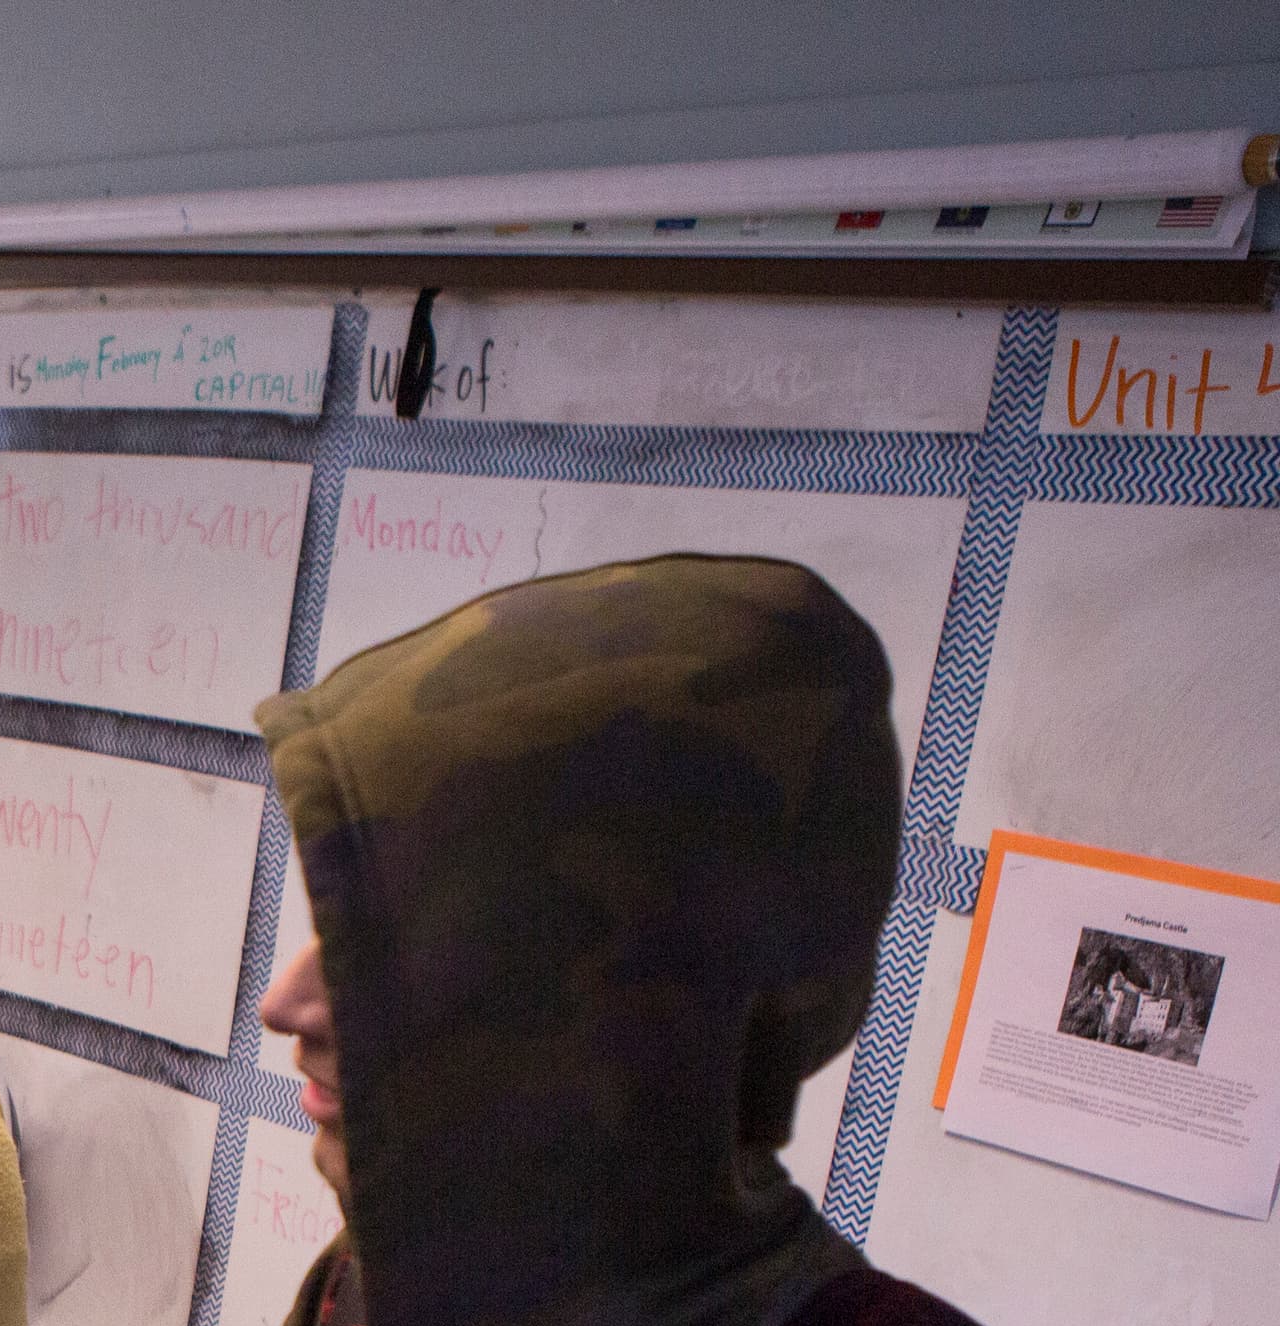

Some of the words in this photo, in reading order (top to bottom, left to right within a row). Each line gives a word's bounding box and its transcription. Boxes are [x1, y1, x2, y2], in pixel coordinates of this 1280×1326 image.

[9, 353, 33, 394] is
[1067, 335, 1231, 436] Unit
[350, 493, 504, 585] Monday
[1162, 920, 1189, 934] Castle
